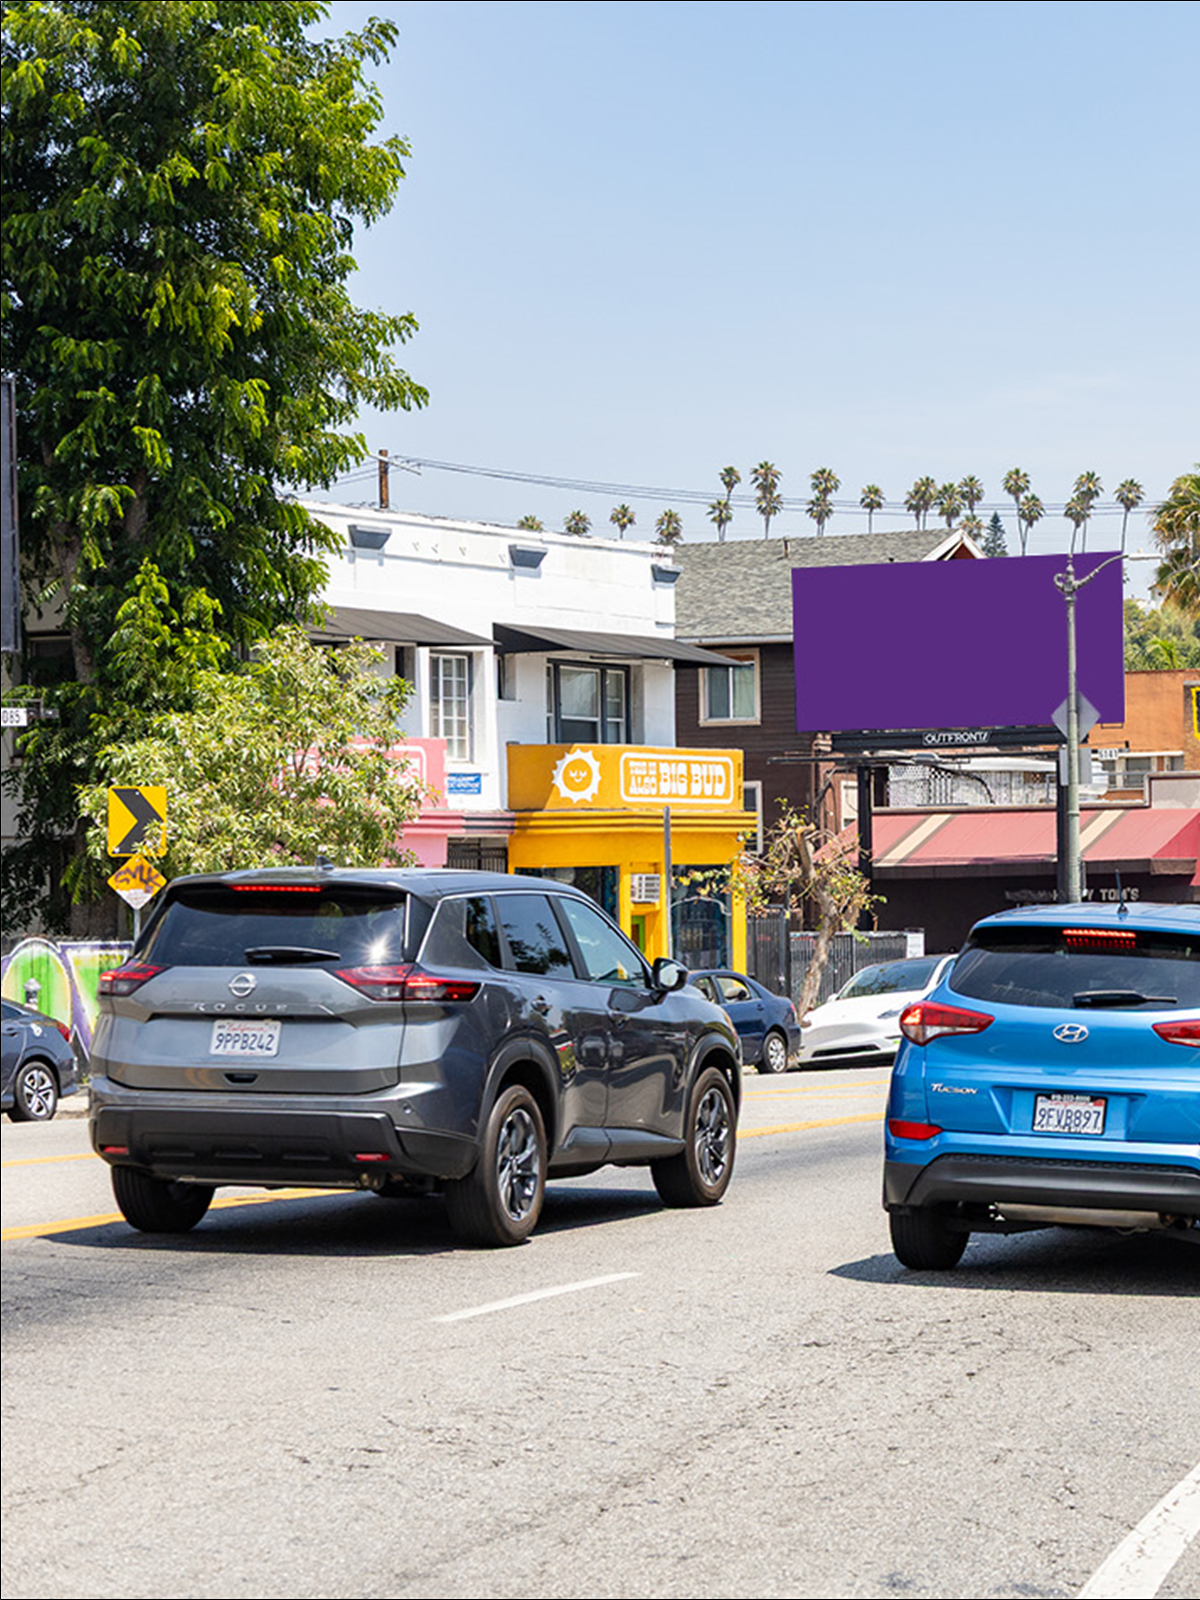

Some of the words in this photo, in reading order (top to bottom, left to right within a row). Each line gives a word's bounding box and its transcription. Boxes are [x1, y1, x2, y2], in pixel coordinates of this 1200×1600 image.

[629, 776, 657, 795] ALSO
[659, 762, 687, 795] BIG
[690, 763, 726, 796] BUD
[1100, 888, 1139, 900] TOM'S
[215, 1033, 275, 1051] 9PPB242
